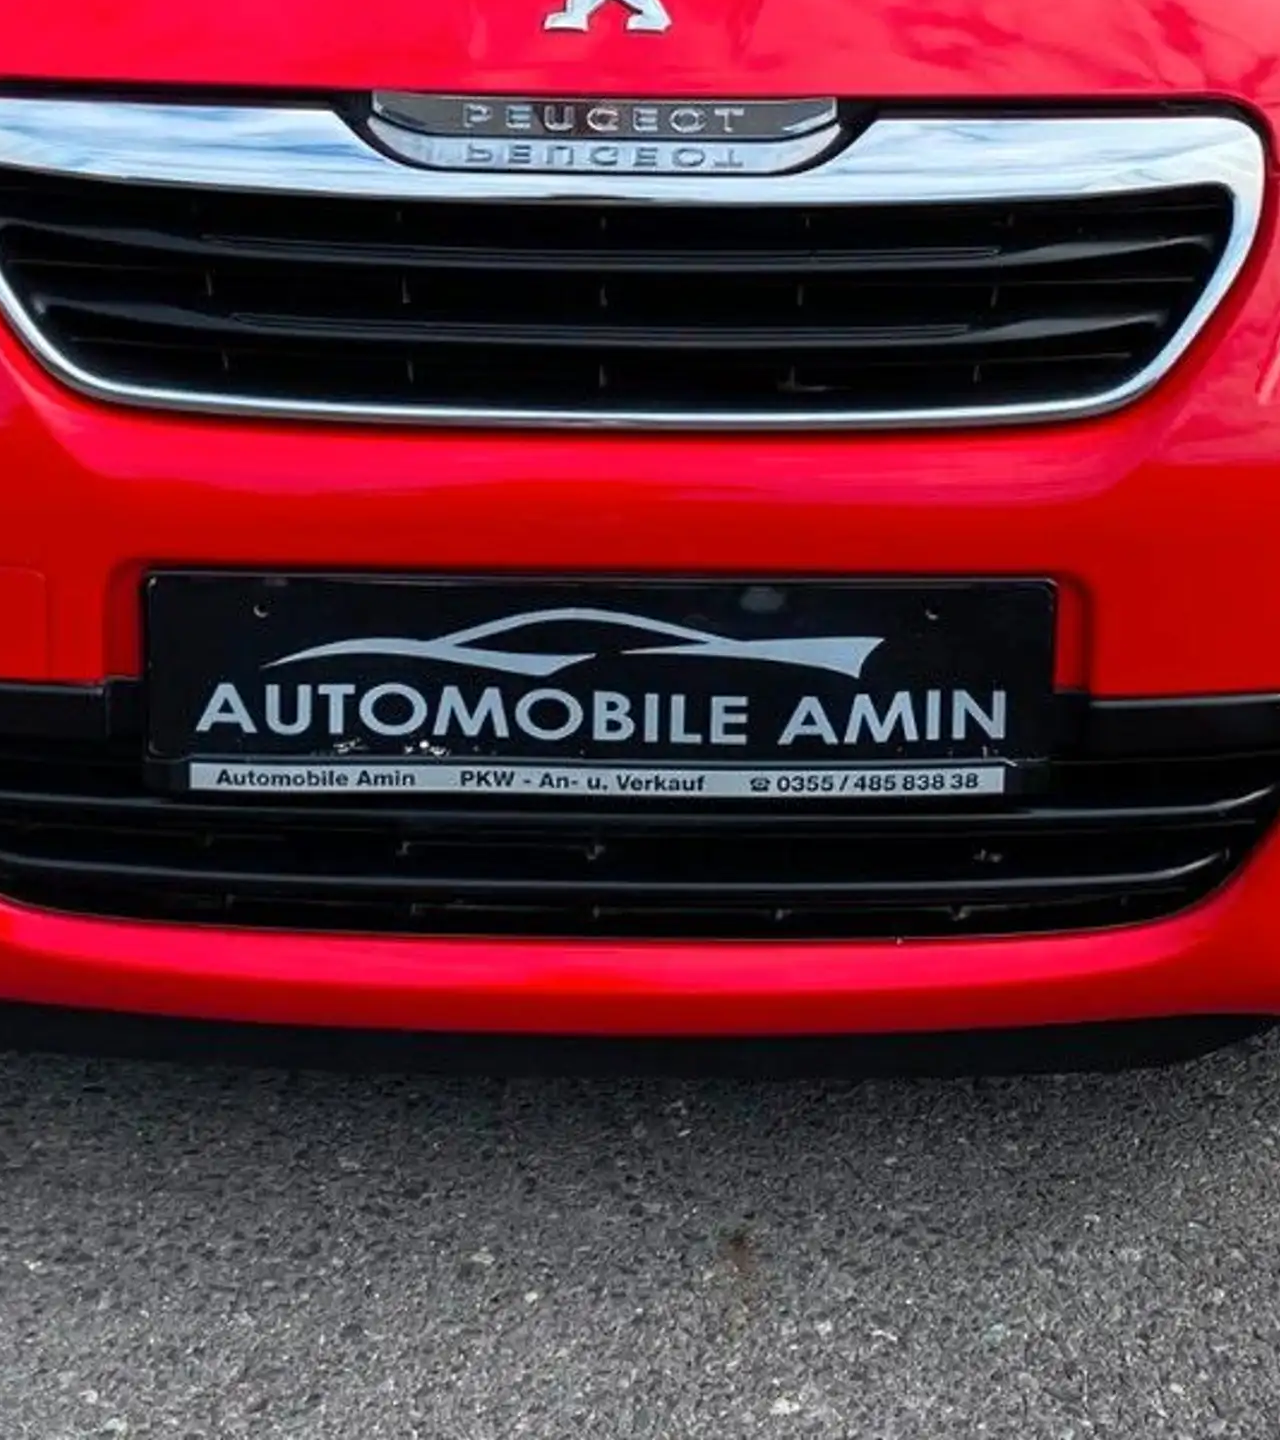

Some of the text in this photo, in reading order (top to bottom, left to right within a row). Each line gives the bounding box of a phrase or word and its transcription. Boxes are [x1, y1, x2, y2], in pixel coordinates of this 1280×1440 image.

[462, 104, 744, 133] PEUGEOT
[195, 682, 1007, 746] AUTOMOBILE AMIN
[216, 769, 350, 788] Automobile
[357, 769, 416, 788] Amin
[459, 770, 515, 788] PKW
[538, 772, 578, 790] An-
[587, 775, 609, 791] u.
[616, 774, 706, 792] Verkauf
